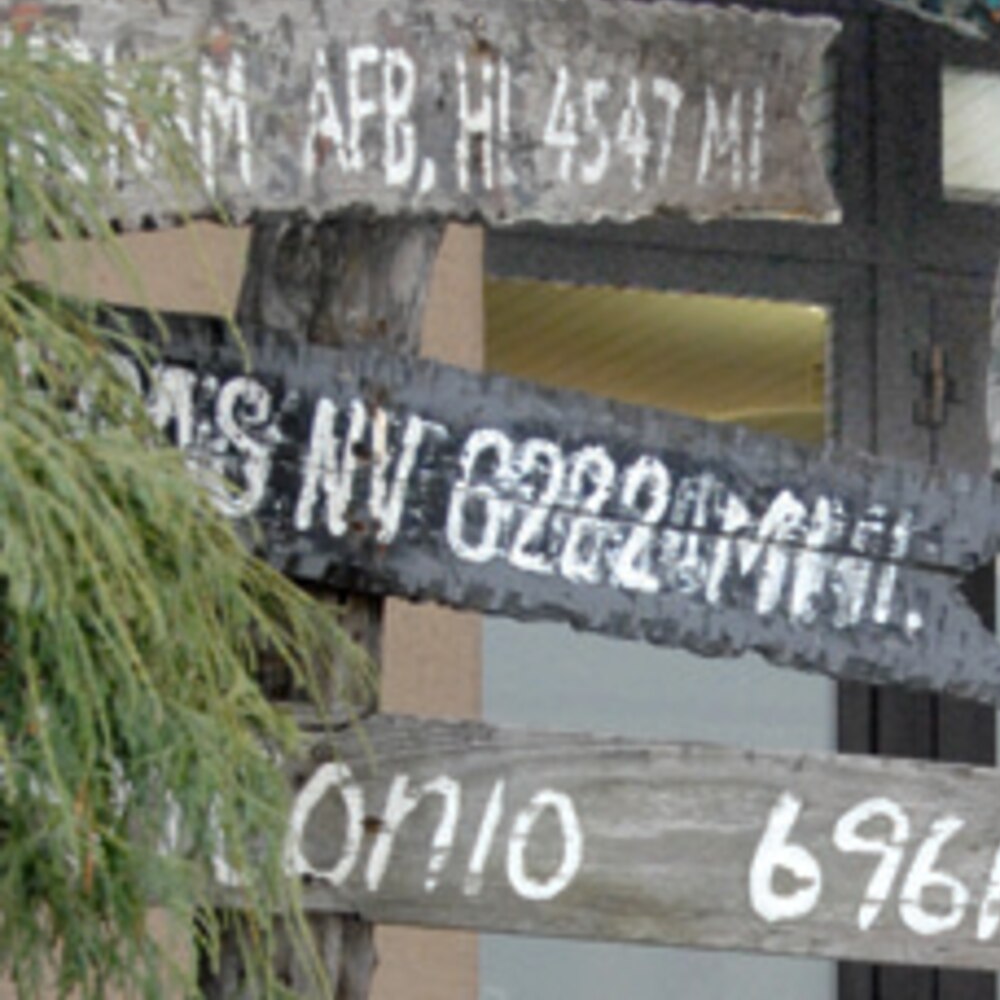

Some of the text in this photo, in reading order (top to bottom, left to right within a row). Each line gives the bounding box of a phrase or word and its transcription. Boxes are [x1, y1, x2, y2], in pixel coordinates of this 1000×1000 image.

[304, 45, 436, 194] AFB,
[543, 65, 685, 192] 4547
[699, 83, 766, 192] MI
